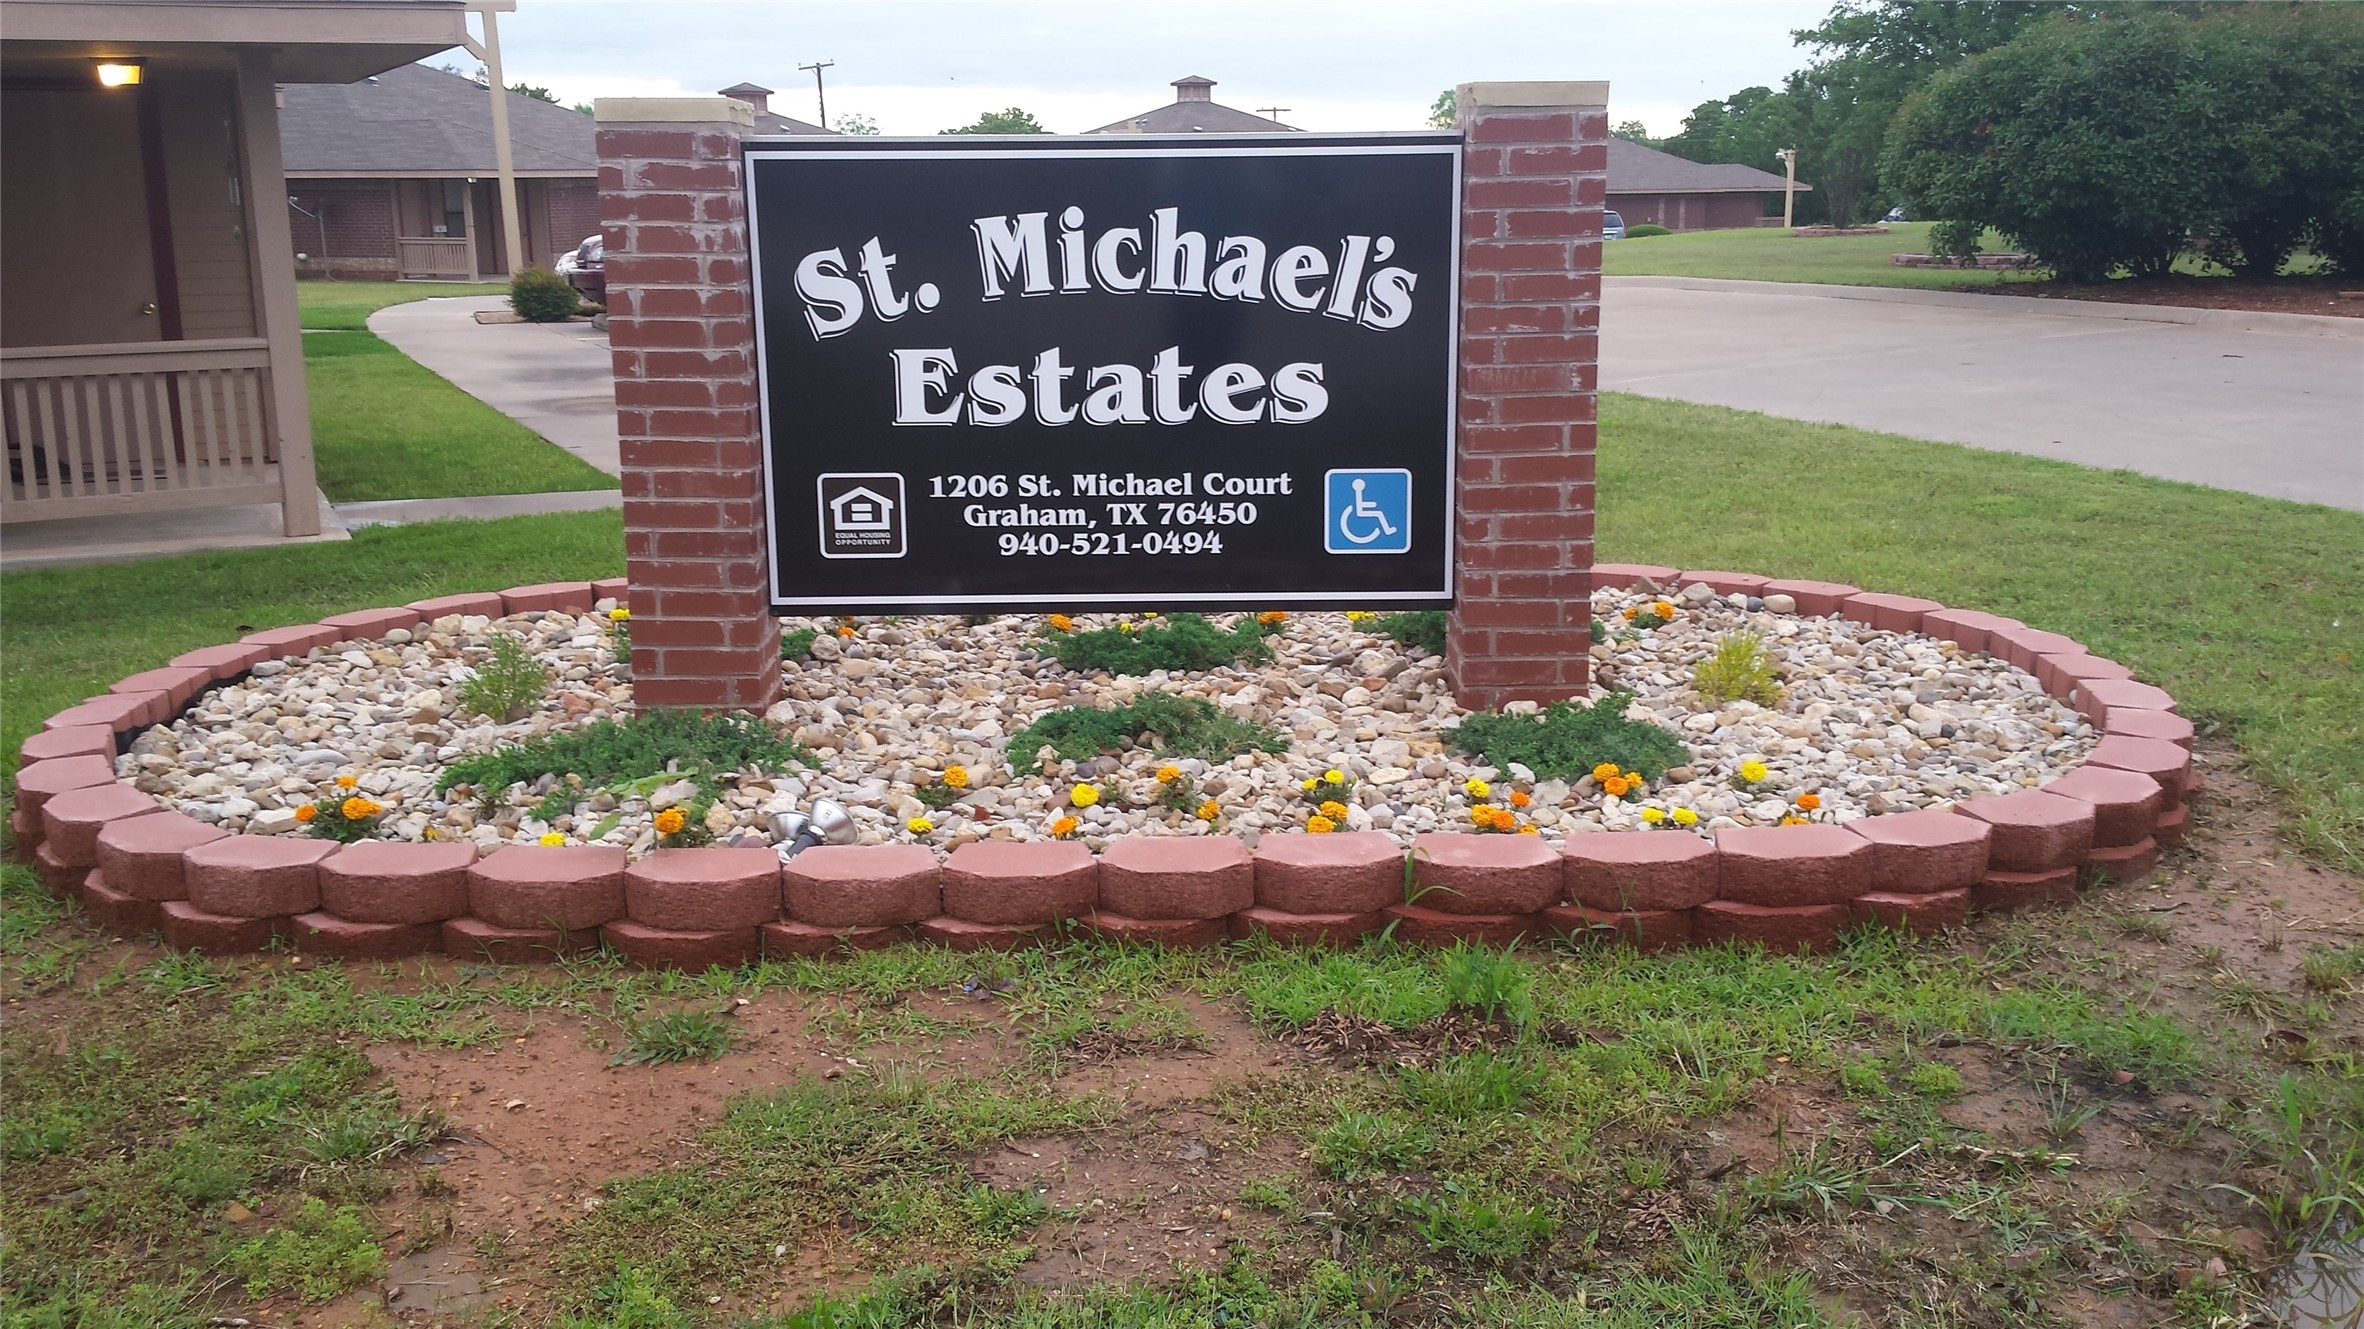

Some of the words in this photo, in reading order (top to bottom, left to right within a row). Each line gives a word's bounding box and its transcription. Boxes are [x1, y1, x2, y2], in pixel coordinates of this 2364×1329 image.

[794, 236, 940, 341] St.
[970, 206, 1417, 331] Michael's
[889, 346, 1329, 426] Estates
[929, 475, 1008, 498] 1206
[1018, 475, 1061, 497] St.
[1072, 472, 1193, 497] Michael
[1203, 472, 1293, 496] Court
[963, 503, 1096, 529] Graham,
[1106, 503, 1148, 526] TX
[1158, 501, 1257, 525] 76450
[999, 530, 1223, 556] 940-521-0494
